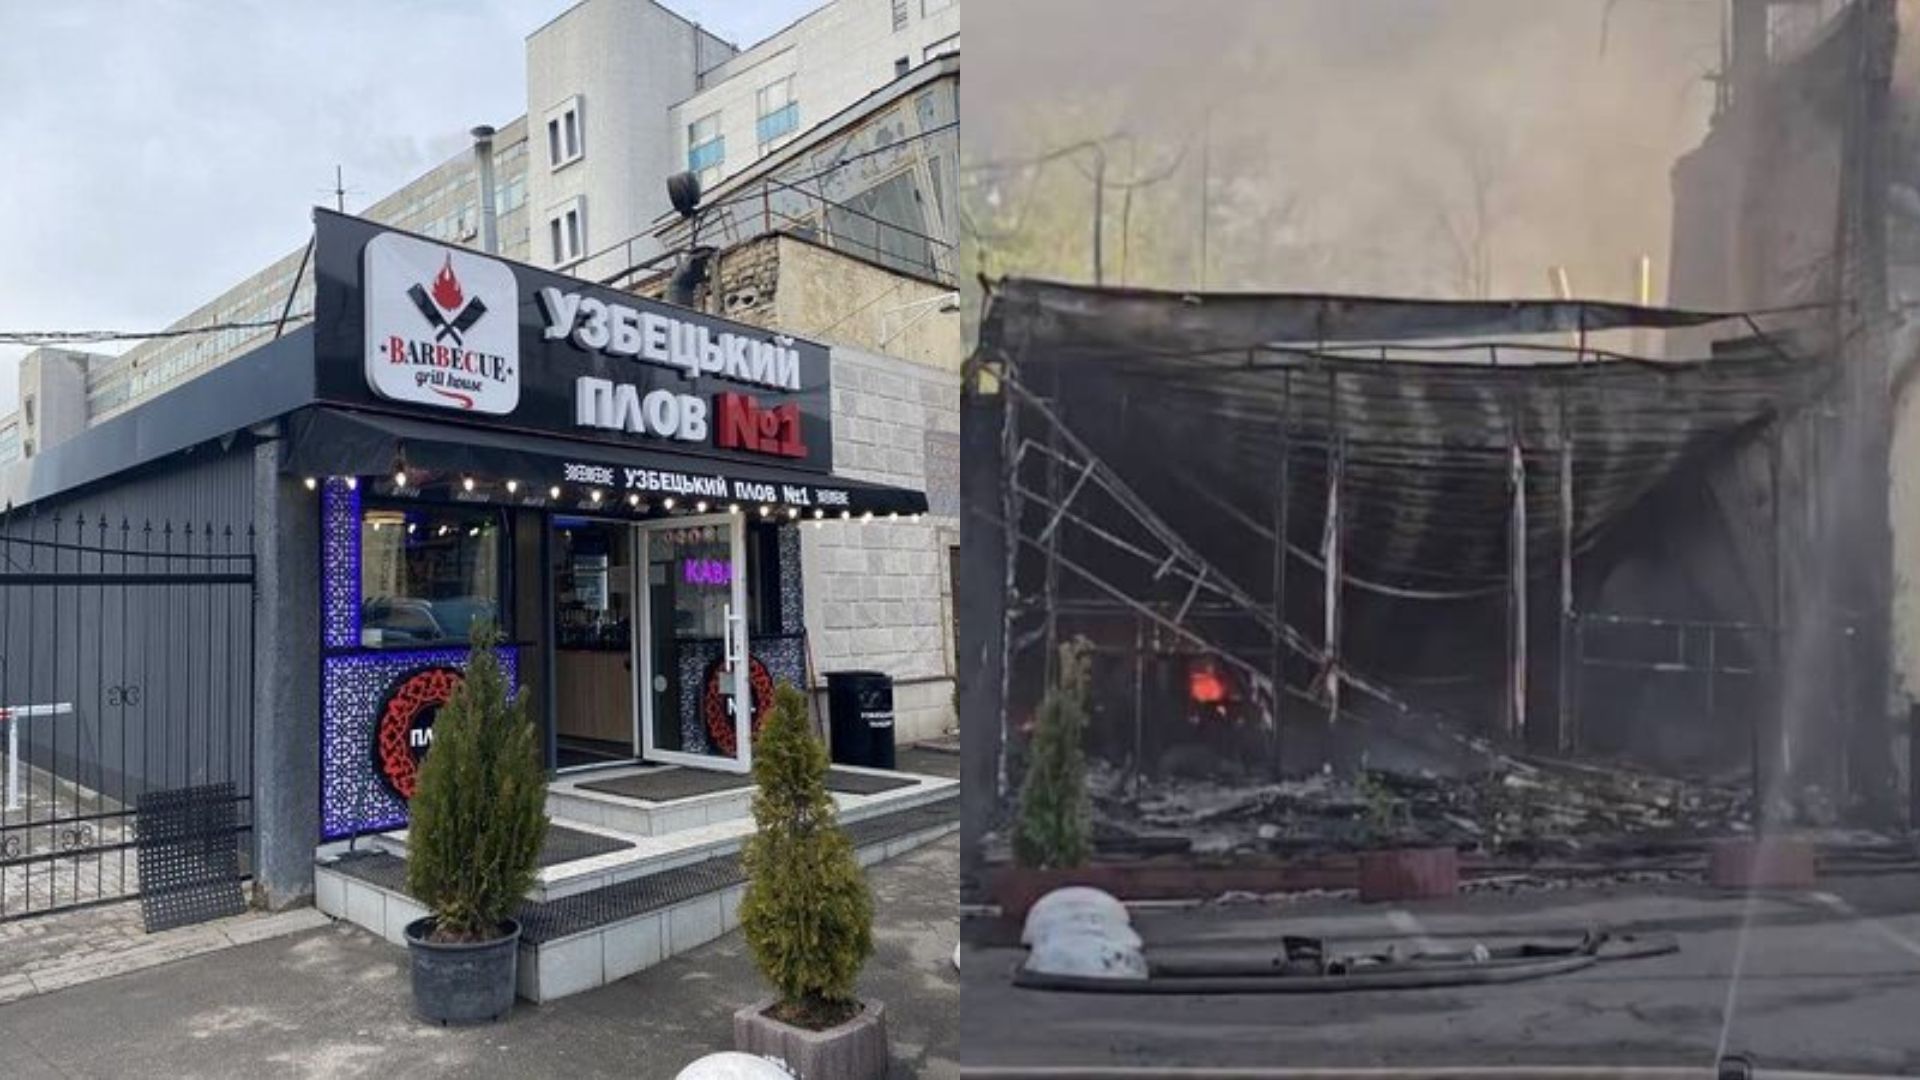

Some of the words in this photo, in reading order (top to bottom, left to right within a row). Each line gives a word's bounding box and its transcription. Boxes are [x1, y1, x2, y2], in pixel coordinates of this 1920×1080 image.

[389, 335, 507, 382] BARBECUE
[540, 287, 800, 390] УЗБЕЦЬКИЙ
[415, 369, 445, 387] grill
[447, 371, 483, 392] house
[575, 376, 707, 441] ПЛОВ
[714, 391, 807, 458] №1
[624, 467, 728, 498] УЗБЕЦЬКИЙ
[734, 481, 777, 502] ПЛОВ
[782, 485, 811, 505] №1
